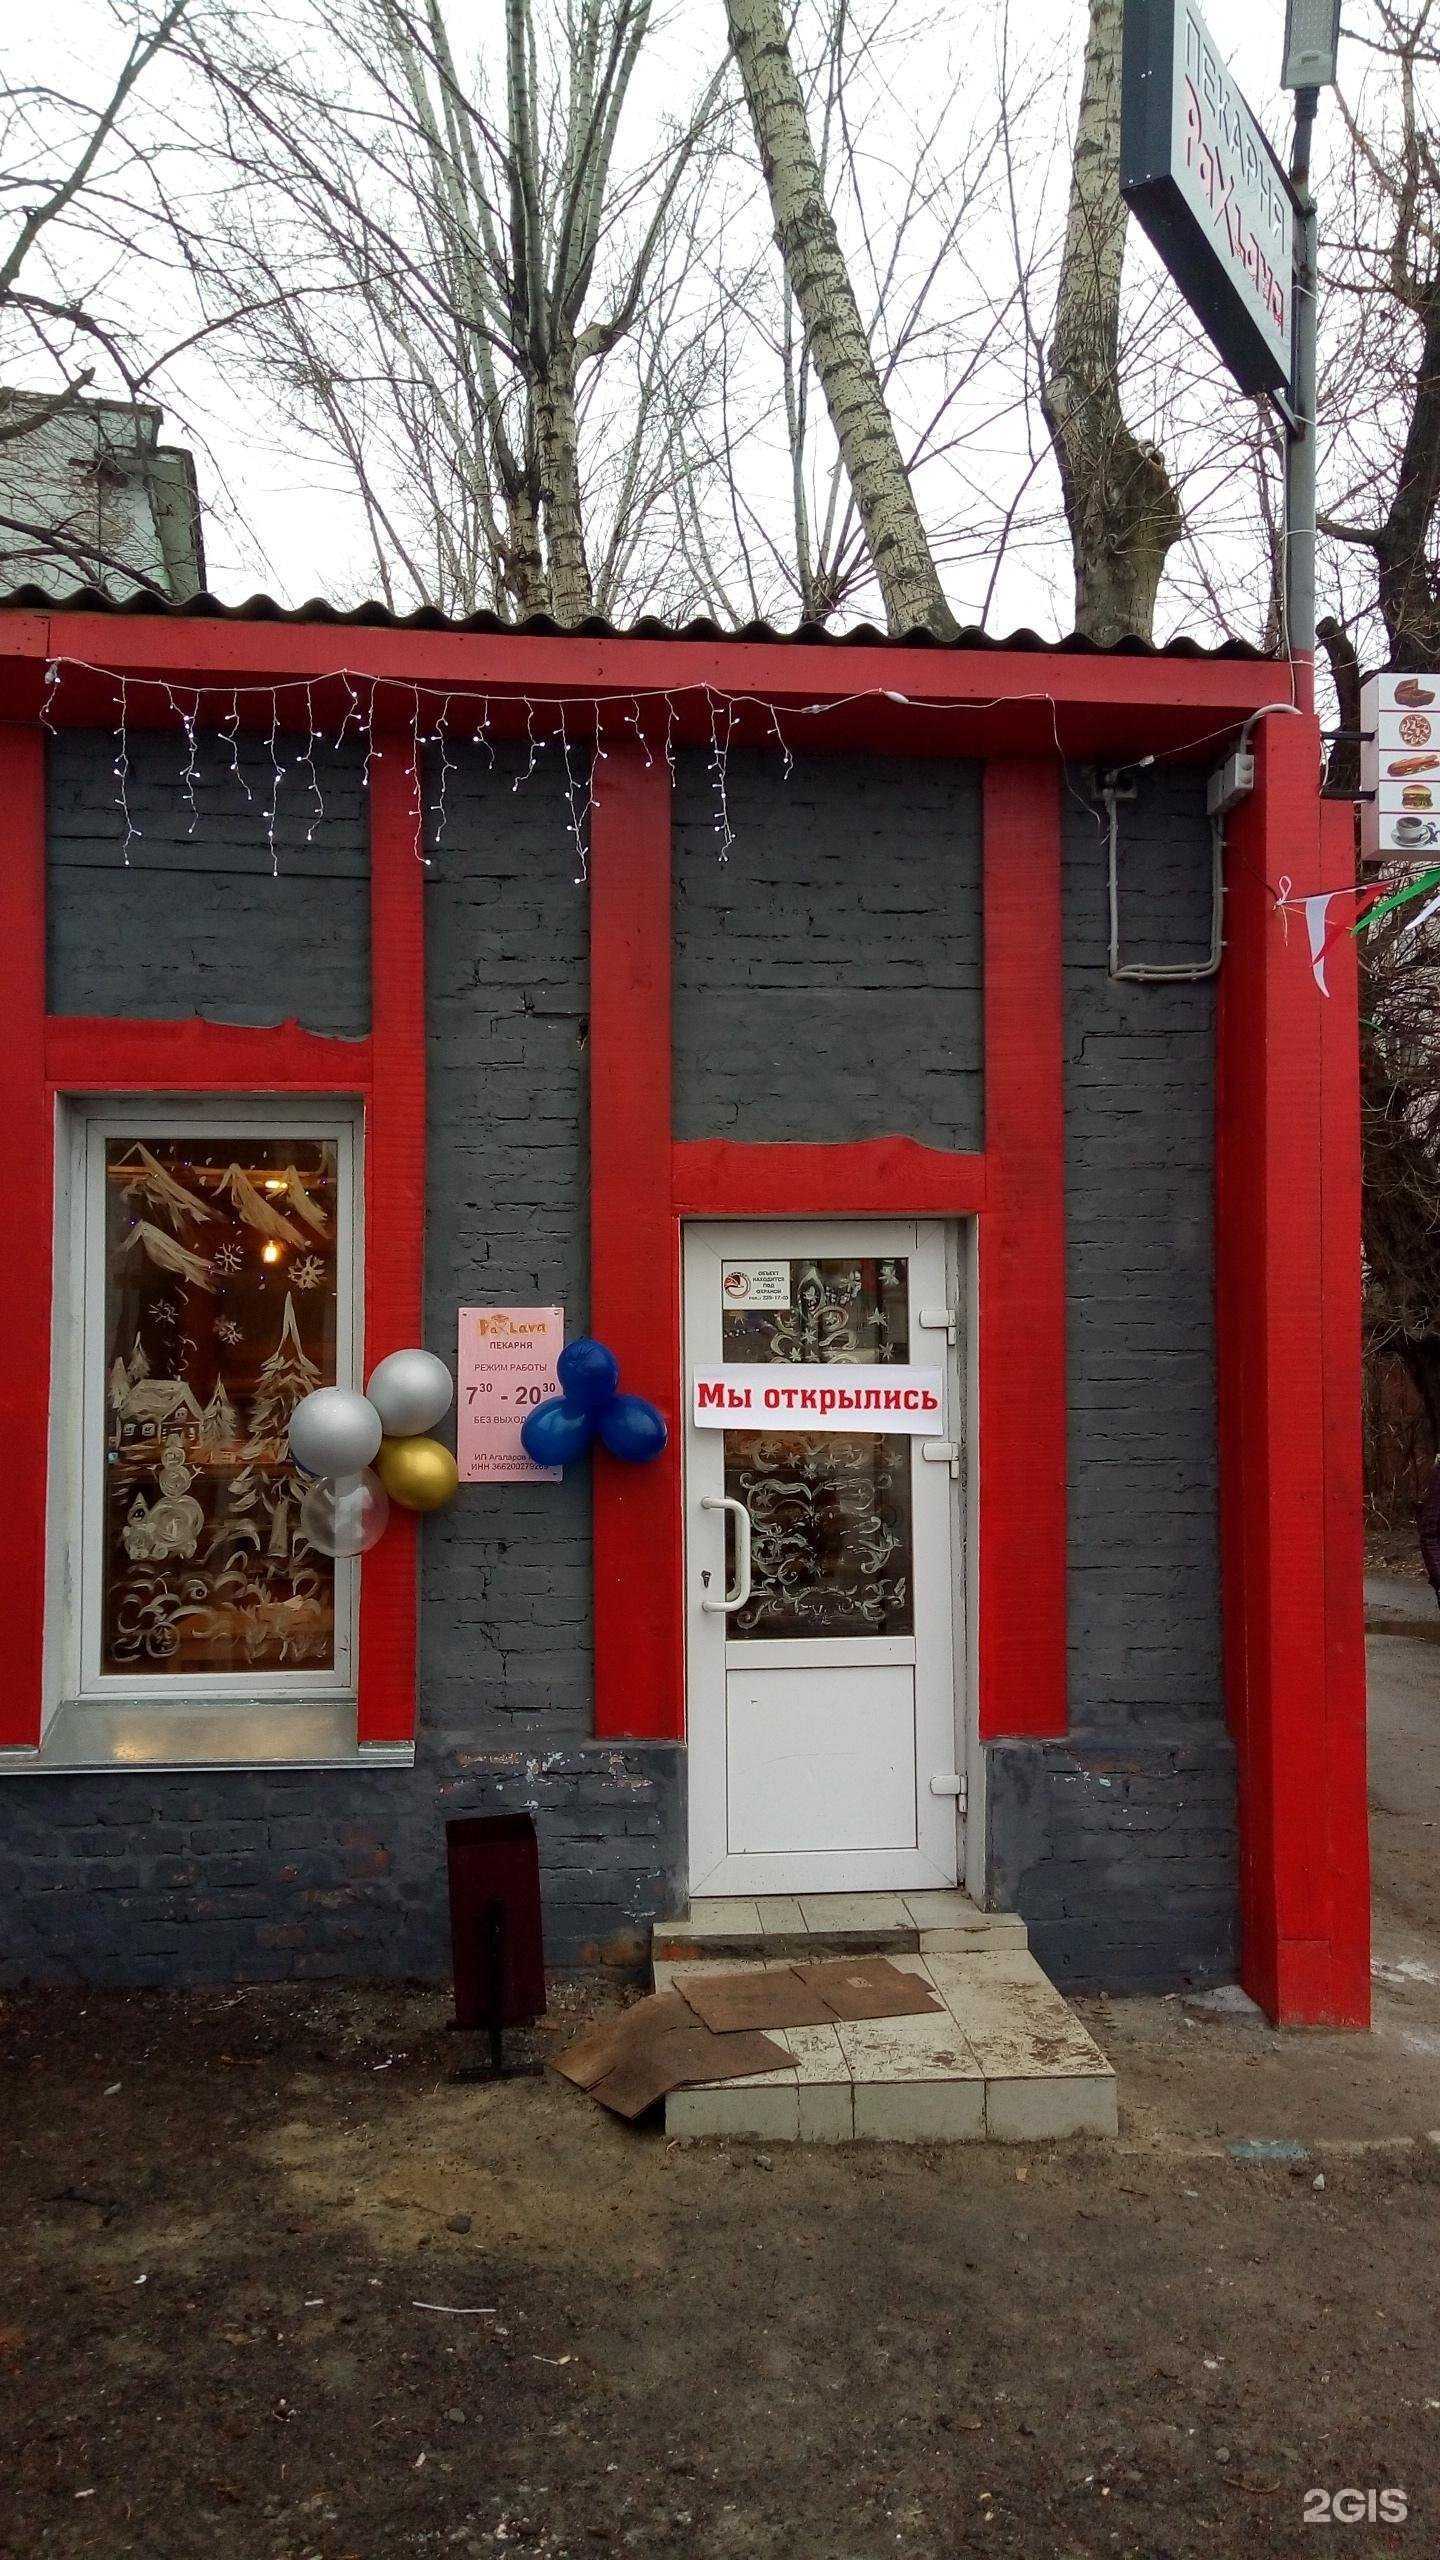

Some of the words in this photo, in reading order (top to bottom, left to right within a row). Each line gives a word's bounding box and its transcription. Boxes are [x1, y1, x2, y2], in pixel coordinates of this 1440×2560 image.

[1186, 7, 1285, 255] ПЕКАРНЯ
[489, 1341, 533, 1350] ПЕКАРНЯ
[474, 1364, 508, 1372] РЕЖИМ
[510, 1364, 547, 1372] РАБОТЫ
[697, 1383, 752, 1409] Мы
[763, 1388, 939, 1415] открылись
[473, 1416, 492, 1425] БЕЗ
[493, 1416, 528, 1425] ВЫХОД
[471, 1463, 490, 1471] ИНН
